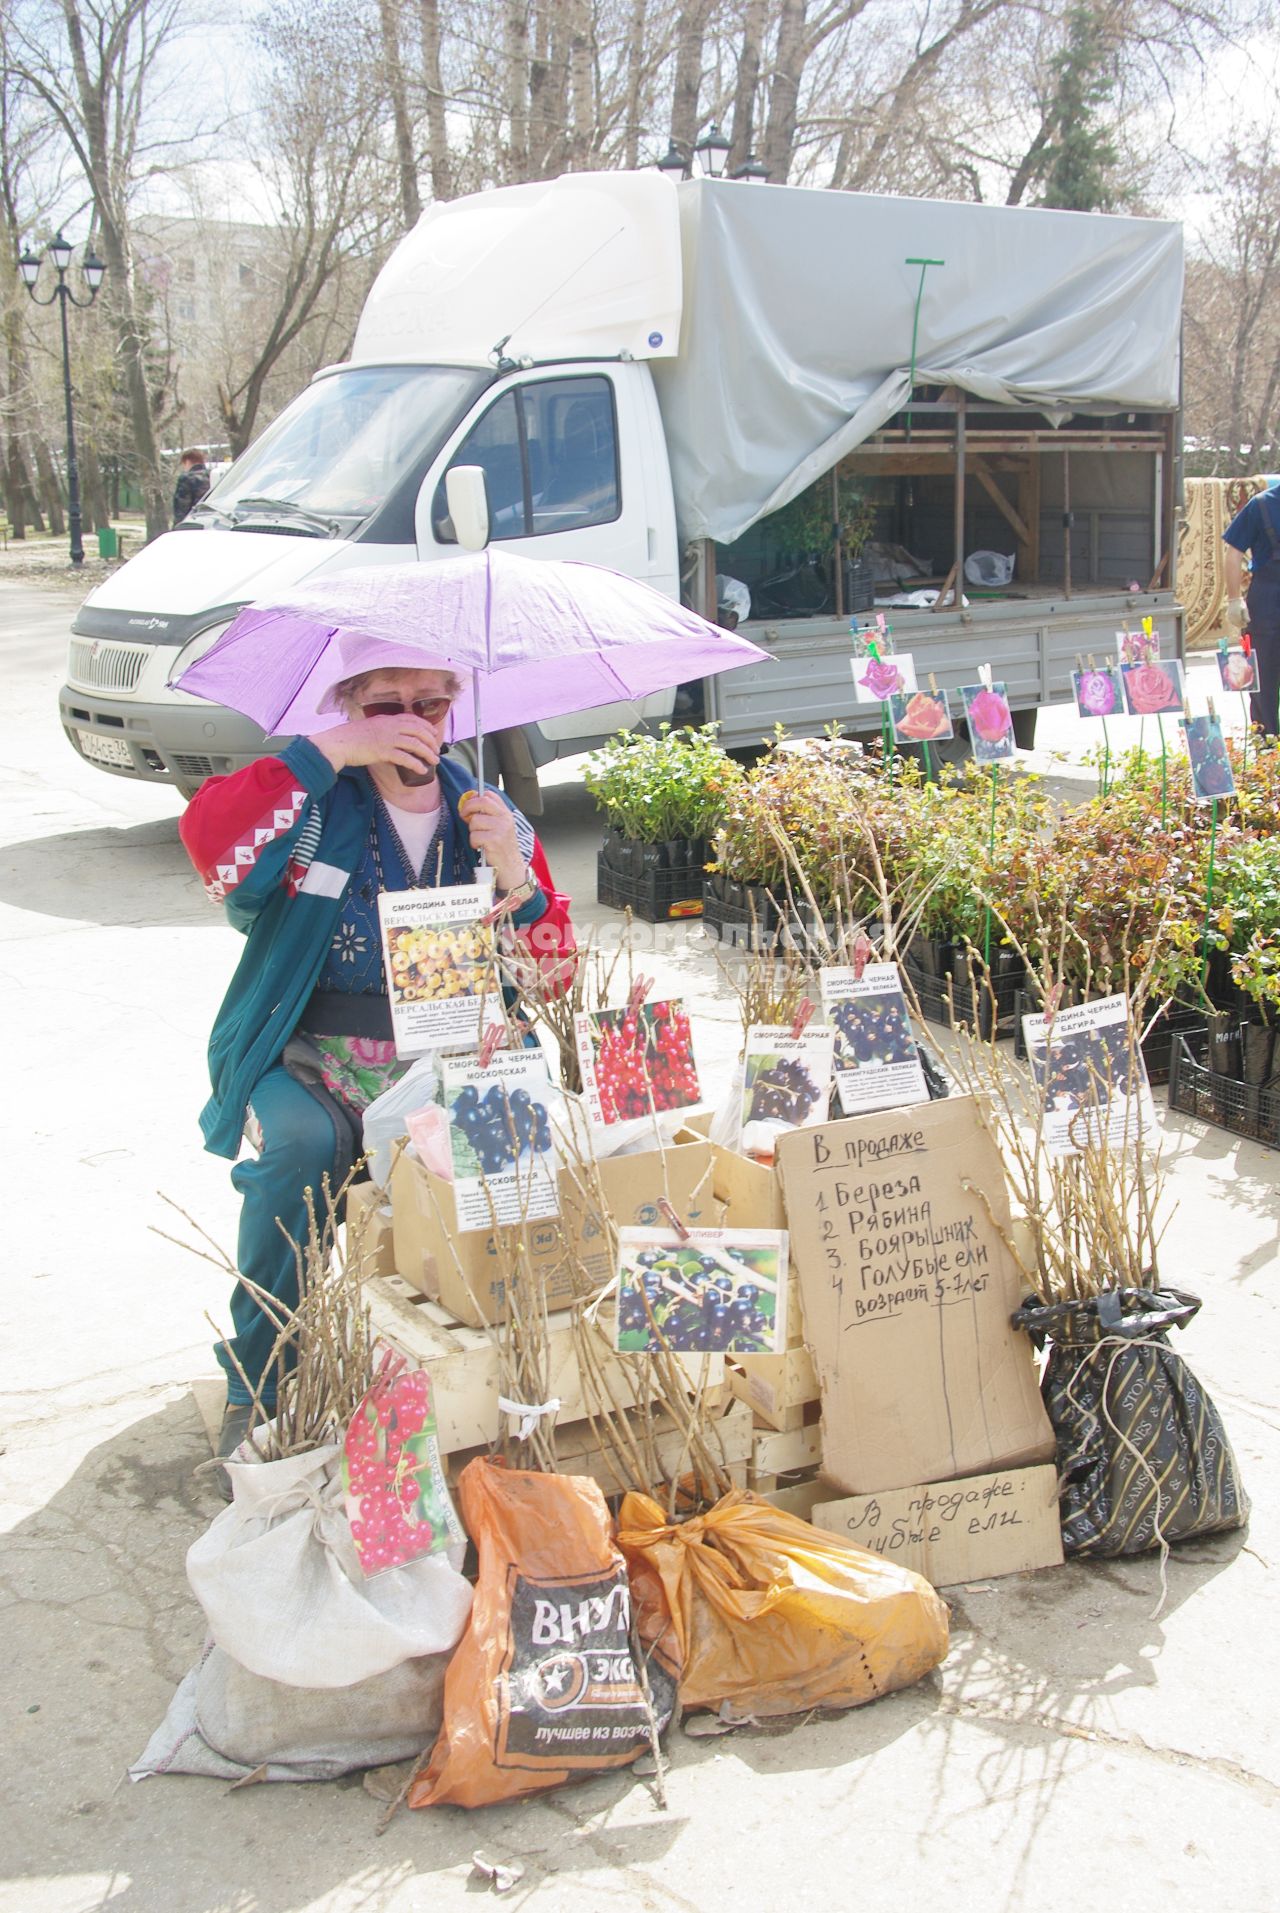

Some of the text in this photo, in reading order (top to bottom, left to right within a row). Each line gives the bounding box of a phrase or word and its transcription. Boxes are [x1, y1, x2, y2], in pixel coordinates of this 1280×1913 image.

[392, 897, 480, 913] СМОРОДИНА БЕЛАЯ
[394, 995, 500, 1015] ВЕРСАЛЬСКАЯ БЕАЯ
[1029, 1000, 1123, 1027] СМООДИНА ЧЕРНАЯ
[1060, 1018, 1097, 1033] БАГИРА
[773, 1042, 808, 1050] ВОЛОГДА
[448, 1052, 544, 1070] СМОРОНА ЧЕРНАЯ
[576, 1020, 603, 1123] Натали
[812, 1134, 831, 1164] В
[815, 1191, 830, 1212] 1
[822, 1220, 840, 1241] 2
[831, 1273, 843, 1295] 4
[534, 1725, 590, 1744] лучшее
[592, 1726, 611, 1740] из
